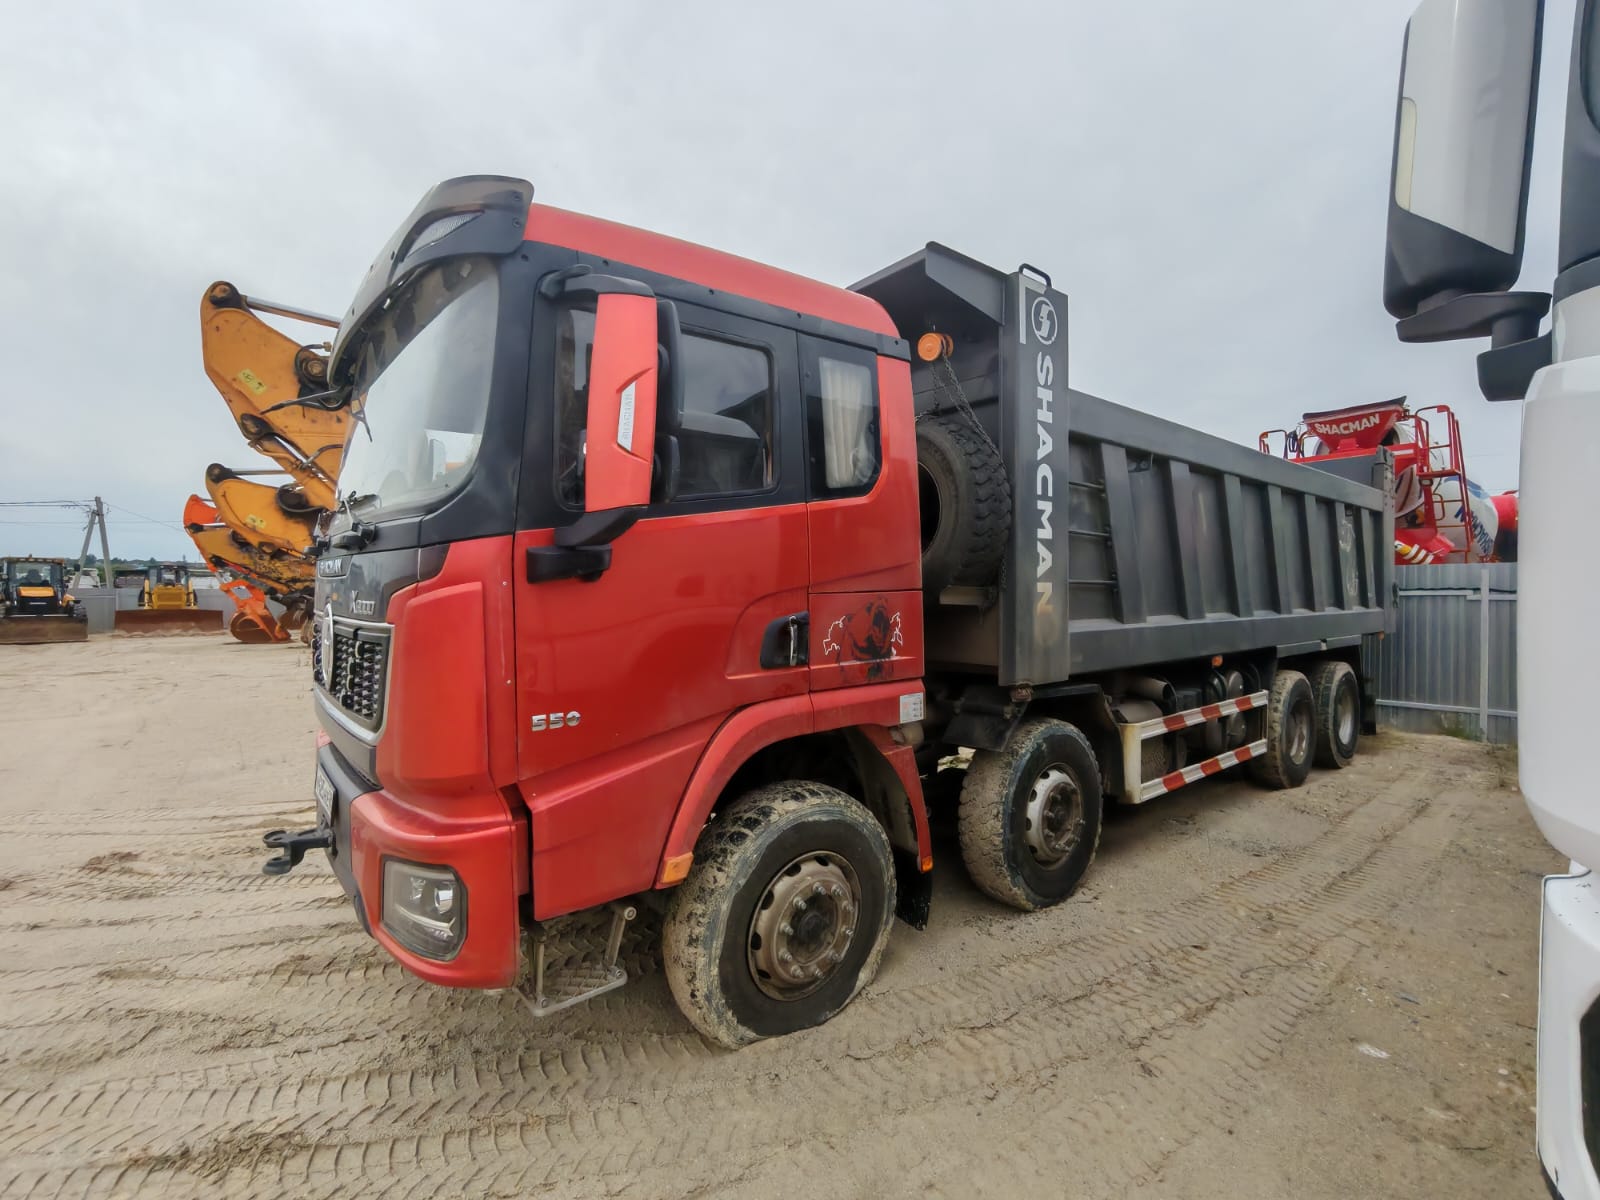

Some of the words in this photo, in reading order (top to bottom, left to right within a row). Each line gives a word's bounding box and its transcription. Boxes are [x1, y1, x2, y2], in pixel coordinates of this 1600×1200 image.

[1314, 413, 1380, 435] SHACMAN
[1036, 351, 1054, 614] SHACMAN
[531, 710, 581, 732] 550
